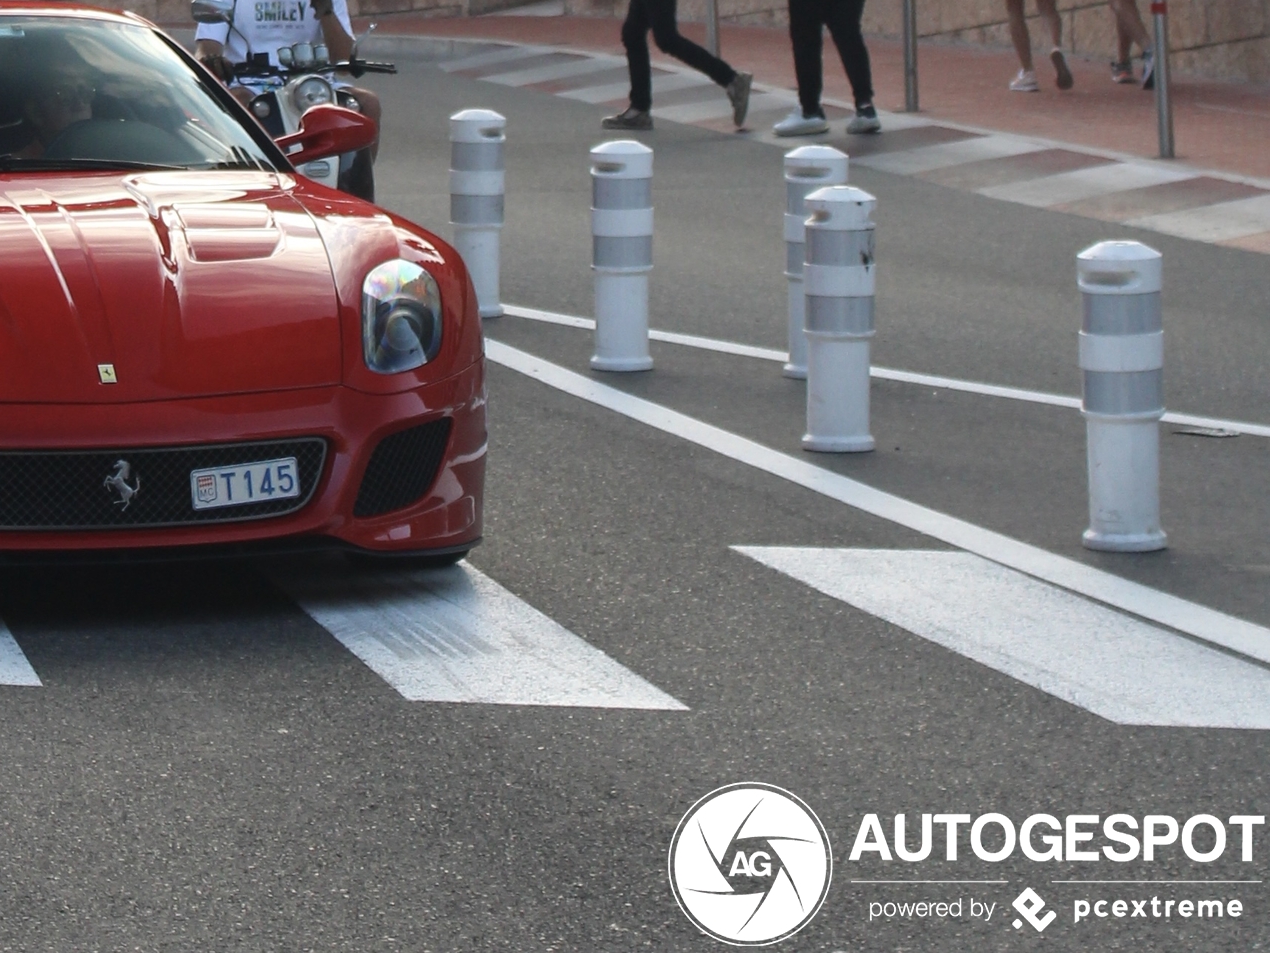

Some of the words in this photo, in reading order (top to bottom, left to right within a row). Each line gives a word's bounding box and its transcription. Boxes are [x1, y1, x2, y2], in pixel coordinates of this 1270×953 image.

[255, 1, 306, 22] SMILEY
[200, 488, 214, 496] MC
[220, 465, 294, 501] T145
